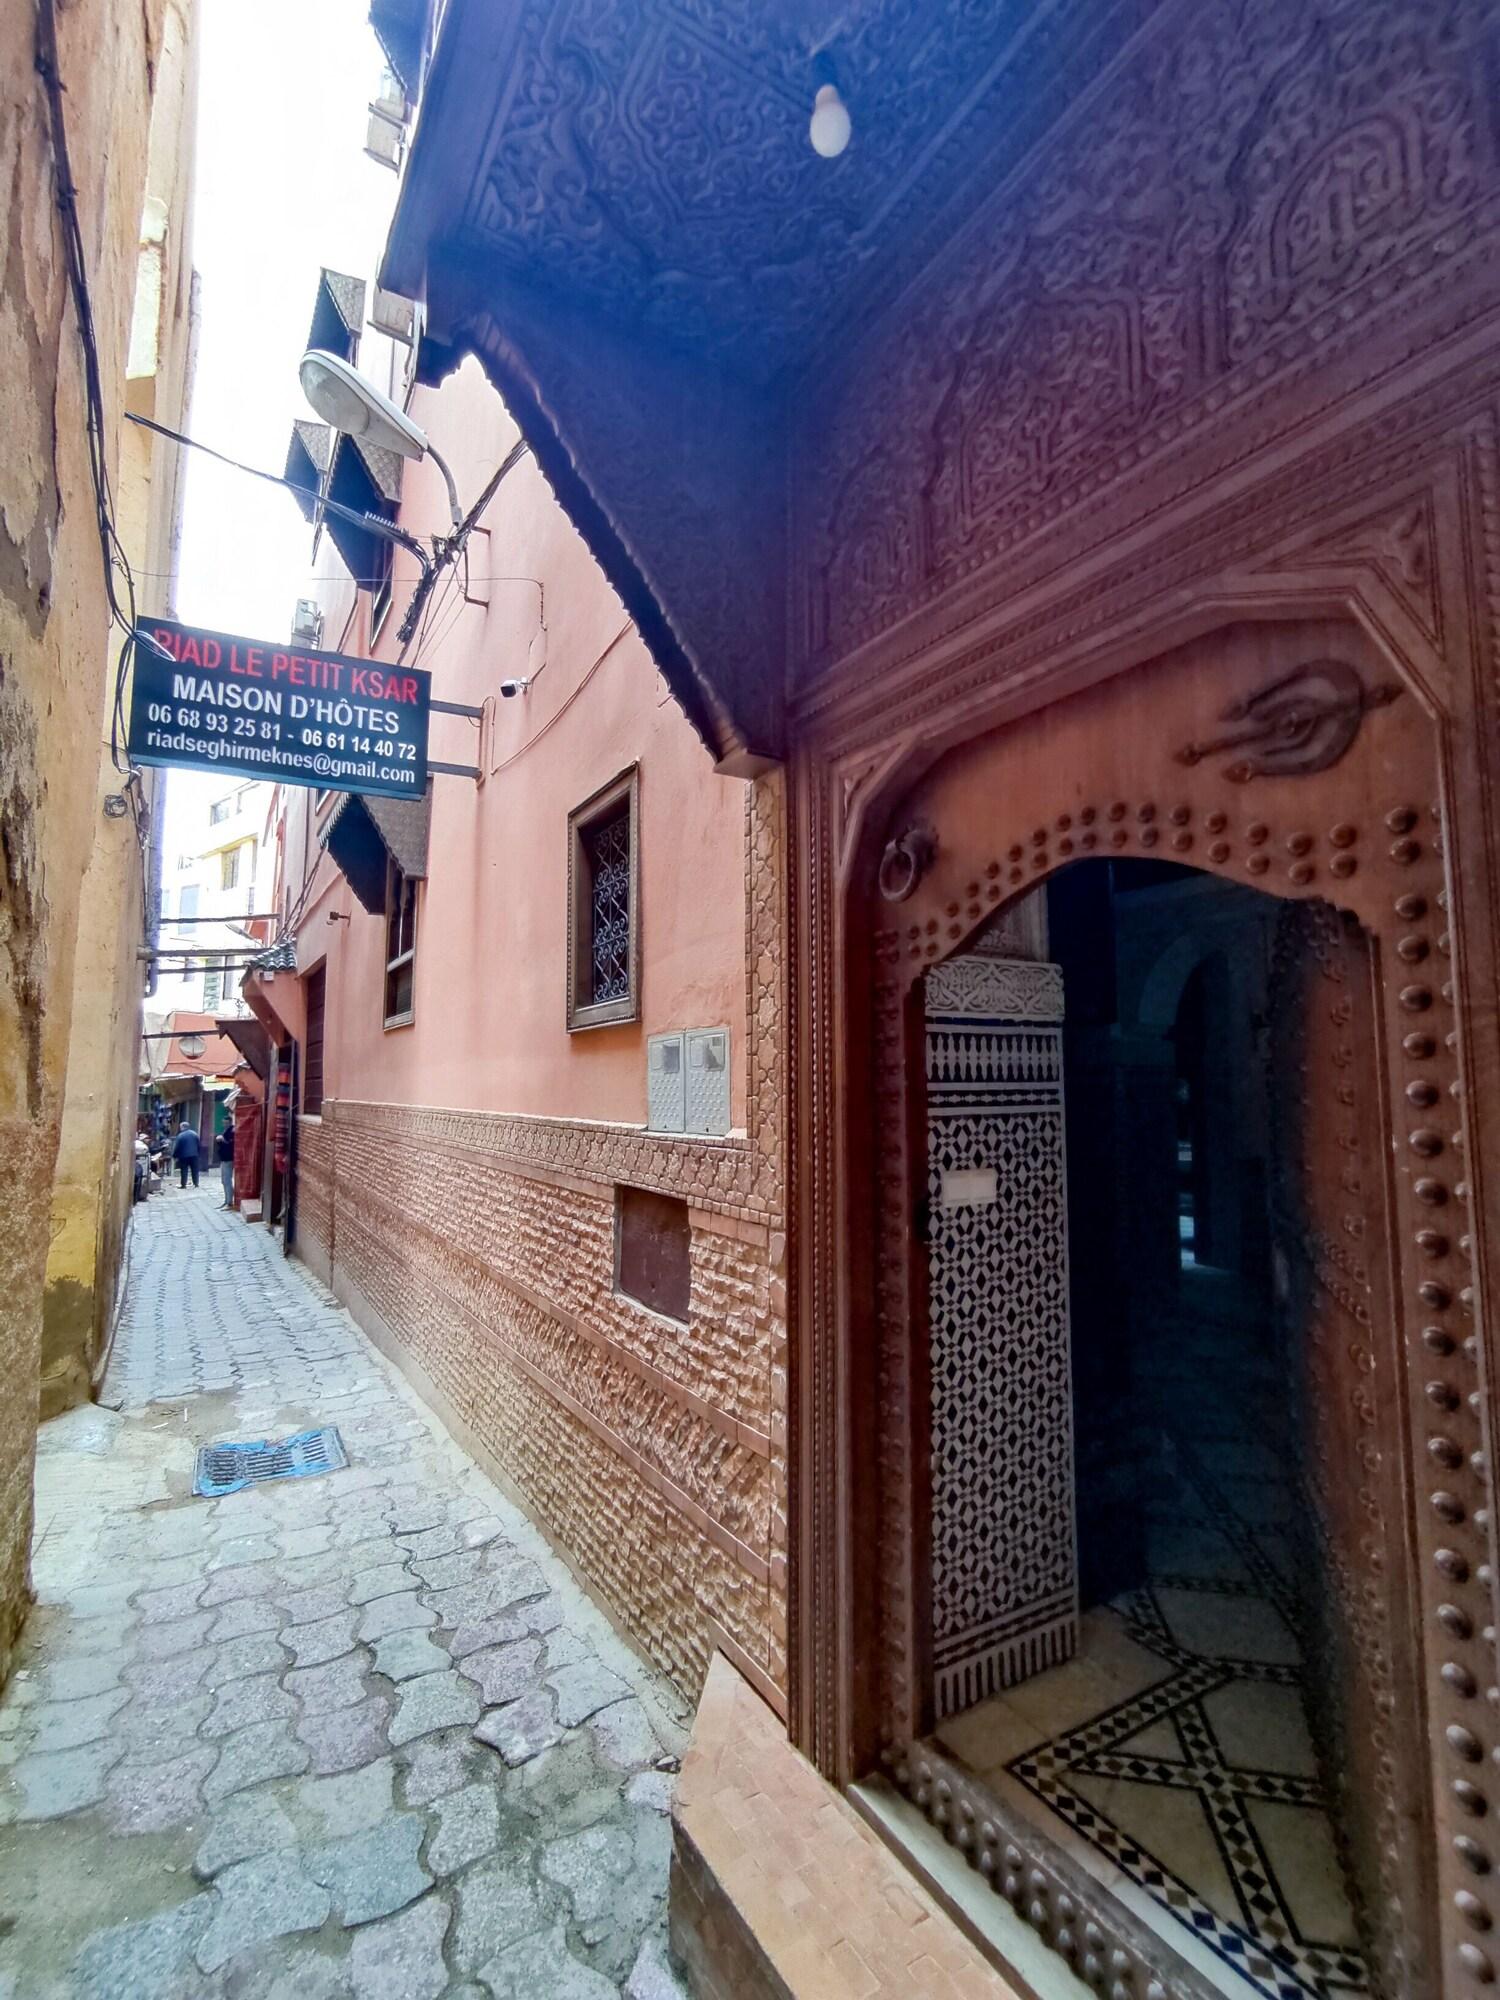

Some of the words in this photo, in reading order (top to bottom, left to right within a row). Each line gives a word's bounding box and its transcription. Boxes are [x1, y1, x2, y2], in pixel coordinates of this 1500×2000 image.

[173, 673, 282, 716] MAISON
[230, 644, 263, 678] LE
[271, 652, 344, 691] PETIT
[351, 667, 418, 705] KSAR
[147, 729, 415, 783] riadseghirmeknes@gmail.com
[148, 703, 172, 724] 06
[177, 708, 200, 729] 68
[206, 712, 228, 733] 93
[233, 717, 256, 737] 25
[260, 721, 281, 741] 81
[302, 728, 323, 747] 06
[326, 732, 345, 751] 61
[351, 736, 370, 754] 14
[374, 740, 393, 757] 40
[398, 743, 417, 760] 72
